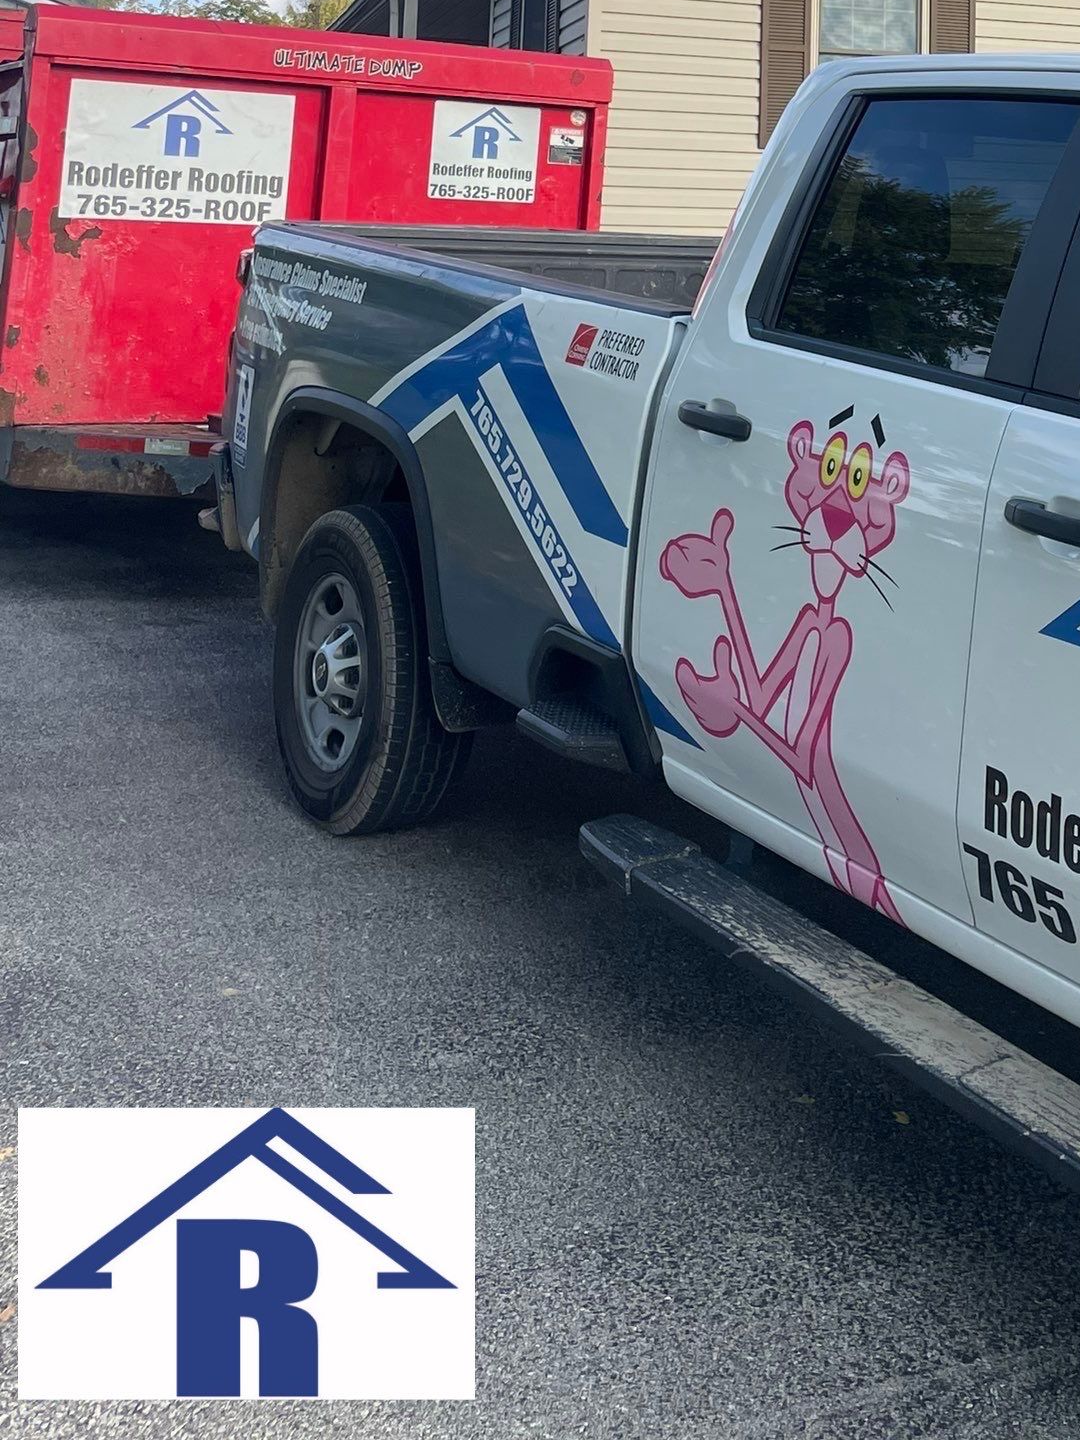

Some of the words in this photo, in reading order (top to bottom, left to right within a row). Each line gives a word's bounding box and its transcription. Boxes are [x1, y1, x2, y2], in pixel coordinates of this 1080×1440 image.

[273, 48, 366, 75] ULTIMATE
[368, 59, 423, 79] DUMP
[67, 159, 182, 193] Rodeffer
[188, 163, 283, 198] Roofing
[432, 162, 484, 181] Rodeffer
[487, 164, 533, 182] Roofing
[77, 193, 272, 222] 765-325-ROOF
[430, 183, 534, 202] 765-325-ROOF
[255, 252, 292, 283] Insurance
[291, 262, 321, 291] Claims
[319, 269, 367, 304] Specialist
[296, 300, 333, 330] Service
[597, 329, 645, 356] PREFERRED
[589, 351, 639, 381] CONTRACTOR
[470, 389, 578, 598] 765.729.5622
